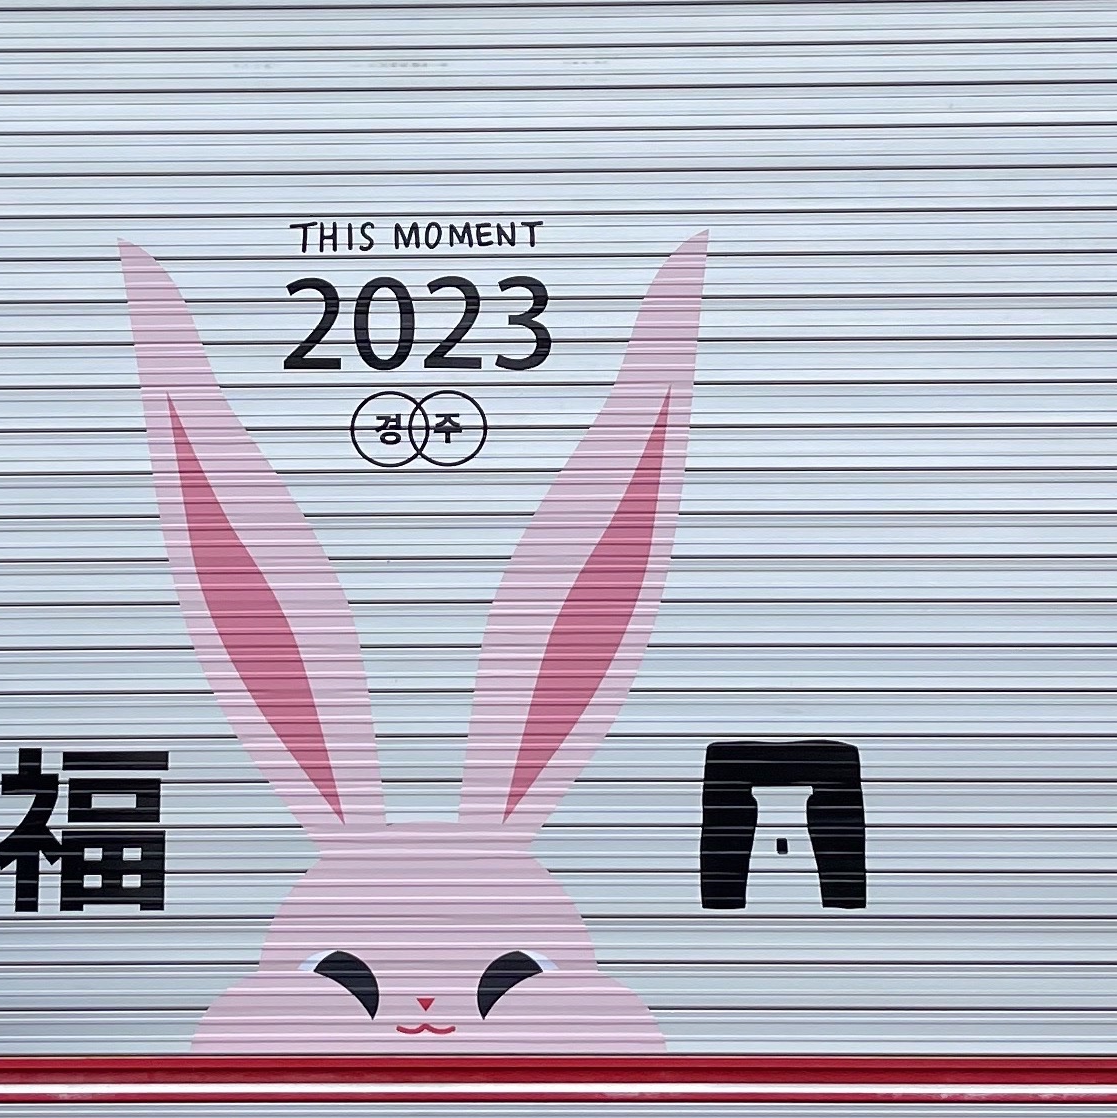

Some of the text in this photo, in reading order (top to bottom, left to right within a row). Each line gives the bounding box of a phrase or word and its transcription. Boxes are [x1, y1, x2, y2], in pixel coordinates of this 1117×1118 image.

[289, 221, 544, 253] THIS MOMENT
[283, 275, 552, 371] 2023
